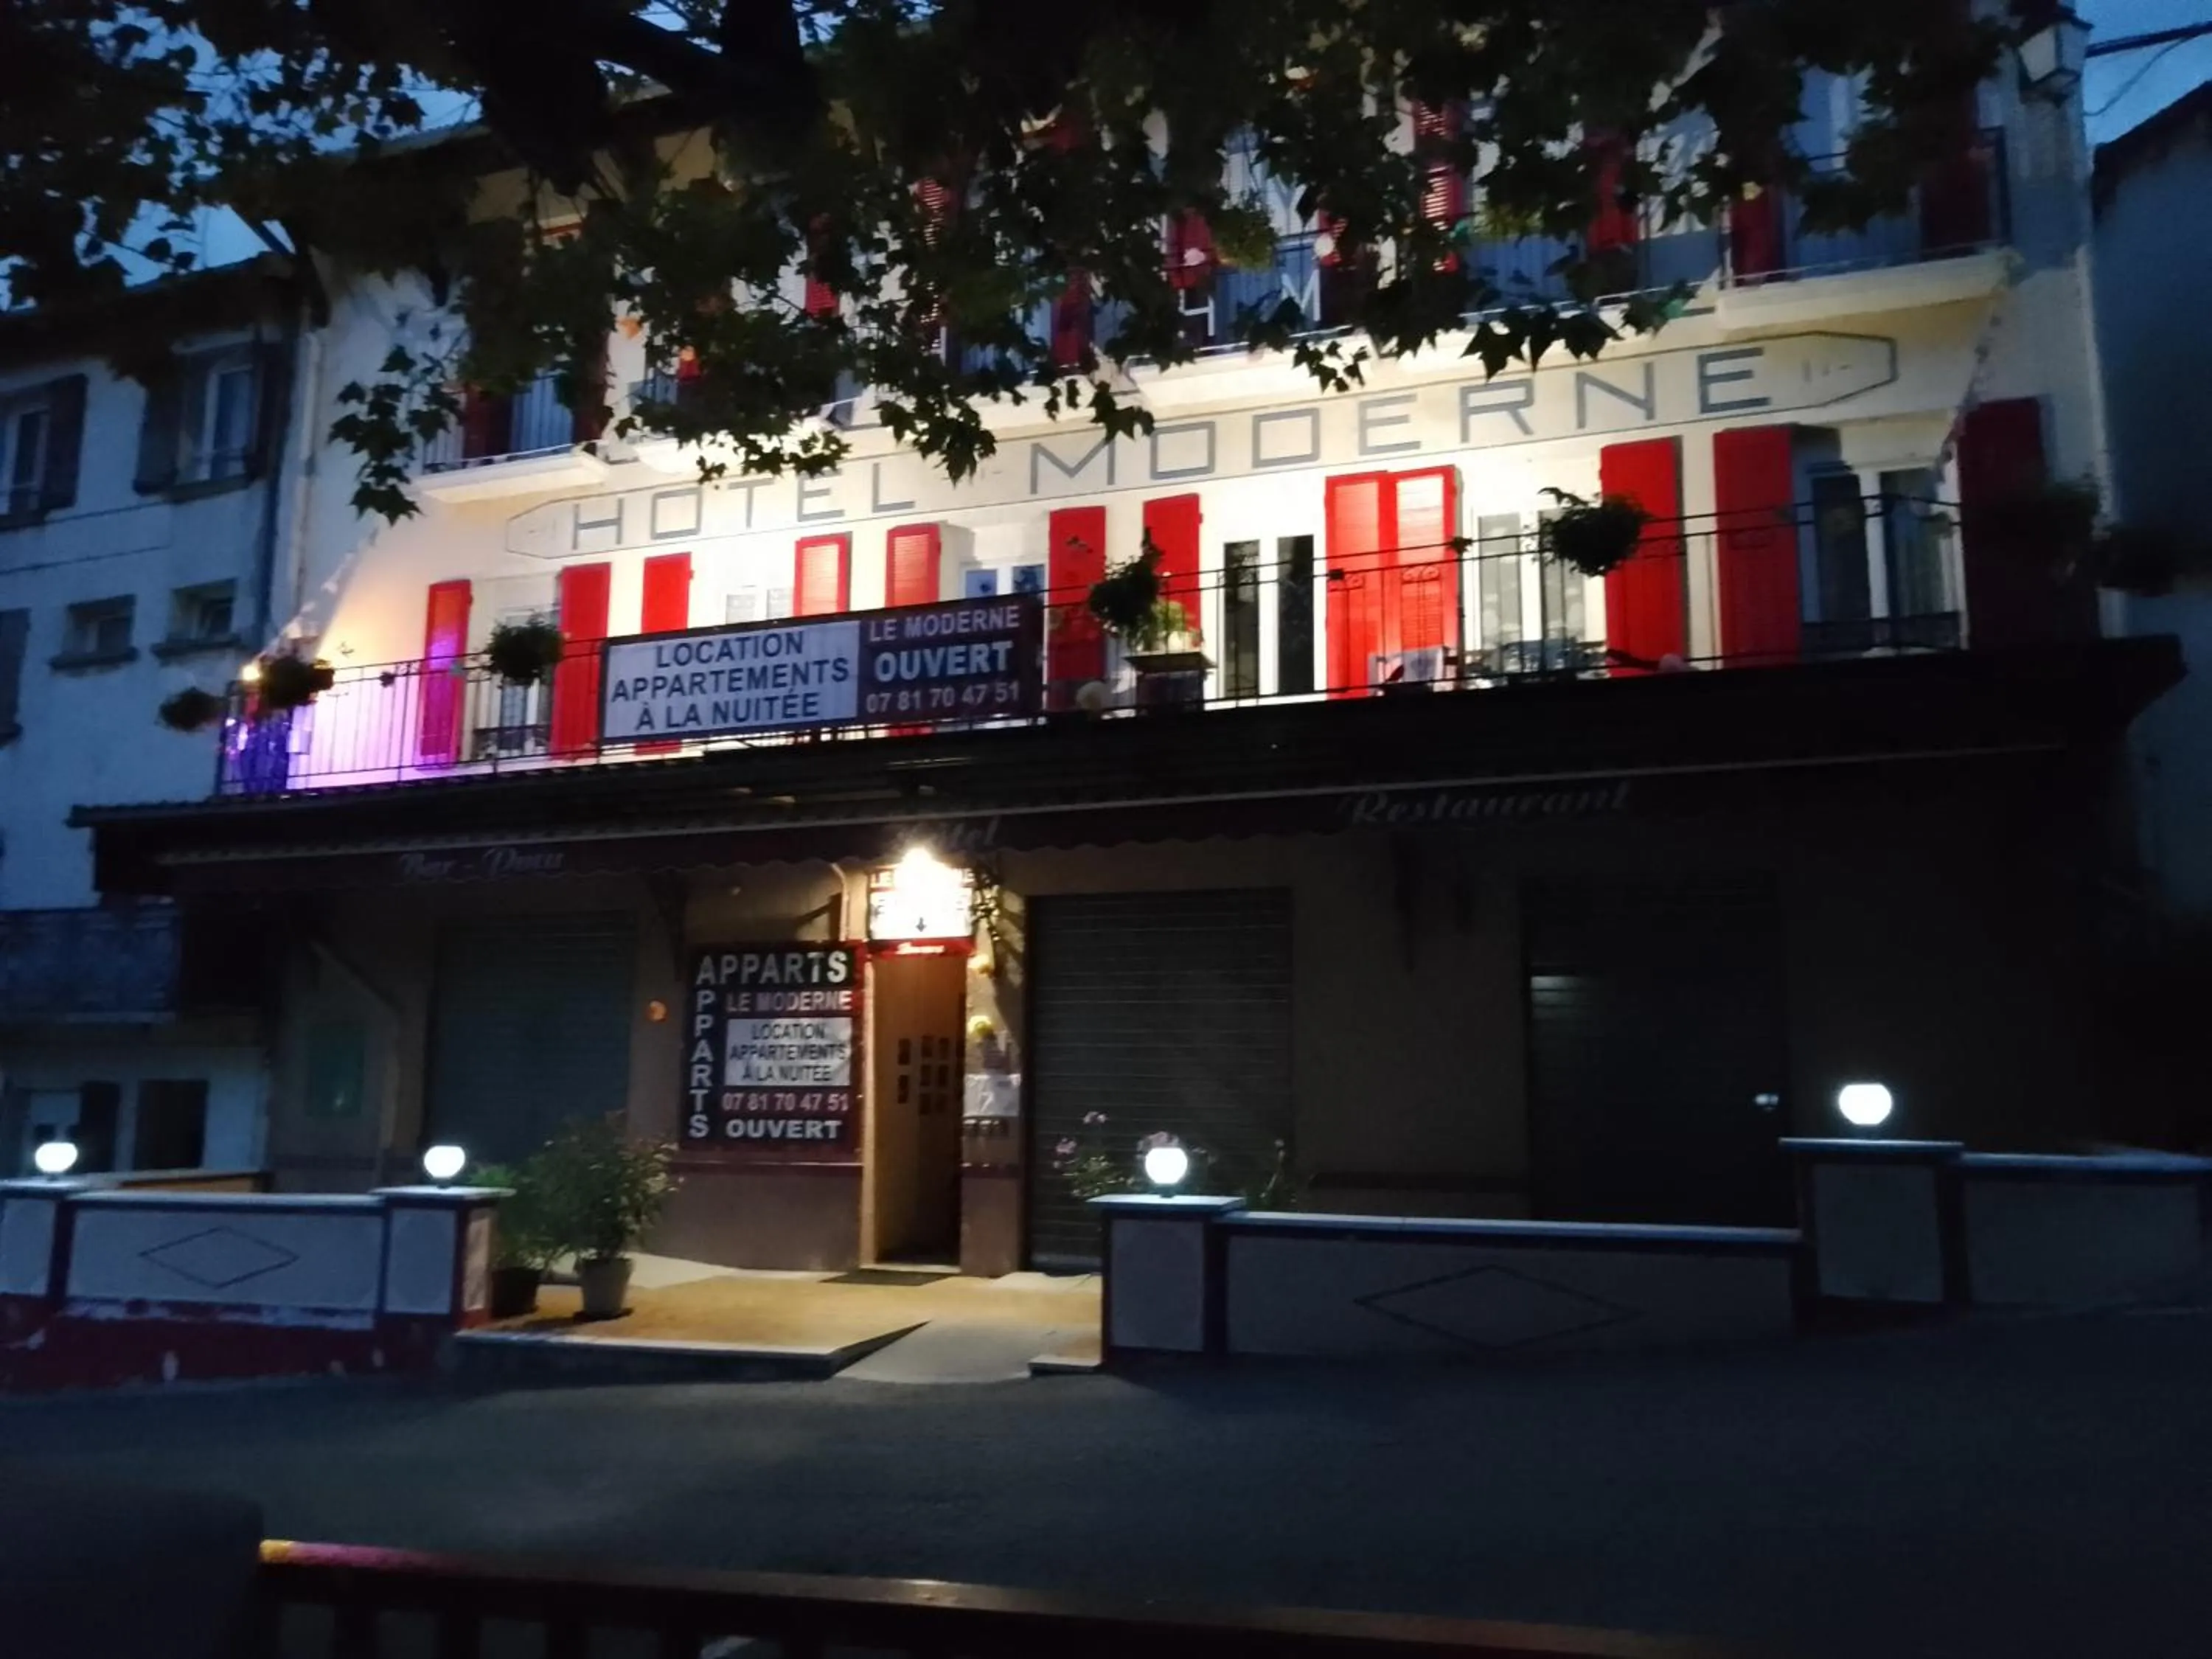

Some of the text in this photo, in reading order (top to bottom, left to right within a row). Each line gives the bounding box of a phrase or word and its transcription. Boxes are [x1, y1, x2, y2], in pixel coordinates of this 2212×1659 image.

[571, 347, 1772, 551] HOTEL MODERNE
[869, 605, 1020, 642] LE MODERNE
[655, 630, 804, 668] LOCATION
[874, 640, 1015, 683] OUVERT
[611, 658, 850, 703] APPARTEMENTS
[866, 681, 1020, 714] 07 81 70 47 51
[666, 703, 702, 729] LA
[712, 687, 821, 726] NUITÉE
[1336, 779, 1630, 823] Restaurant
[695, 950, 848, 985] APPARTS
[725, 990, 853, 1012] LE MODERNE
[751, 1023, 827, 1040] LOCATION
[728, 1043, 847, 1061] APPARTEMENTS
[722, 1092, 744, 1112] 07
[750, 1092, 767, 1111] 81
[774, 1092, 795, 1111] 70
[801, 1092, 822, 1111] 47
[725, 1119, 843, 1138] OUVERT
